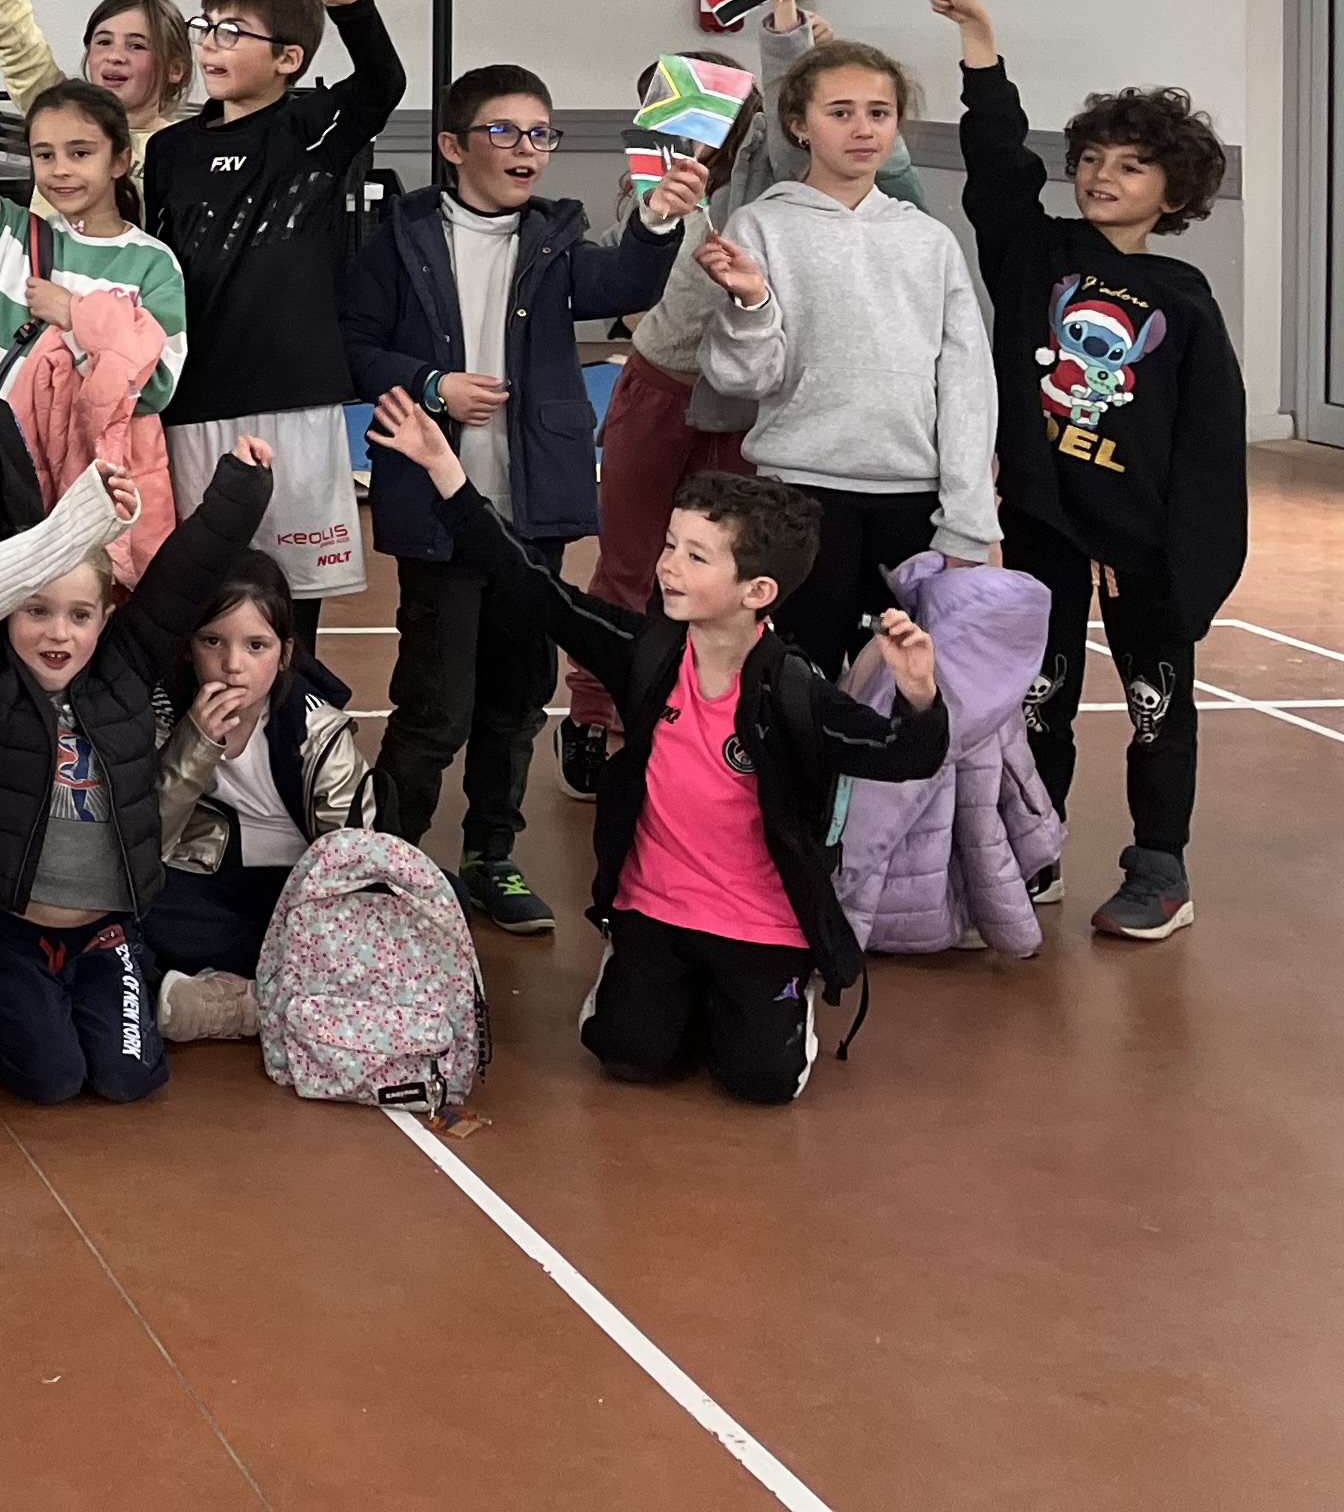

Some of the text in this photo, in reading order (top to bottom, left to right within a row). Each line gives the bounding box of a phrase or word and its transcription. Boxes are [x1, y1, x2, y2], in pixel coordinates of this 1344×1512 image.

[210, 155, 247, 172] FXV
[122, 990, 140, 1024] NEW
[121, 1022, 141, 1061] YORK
